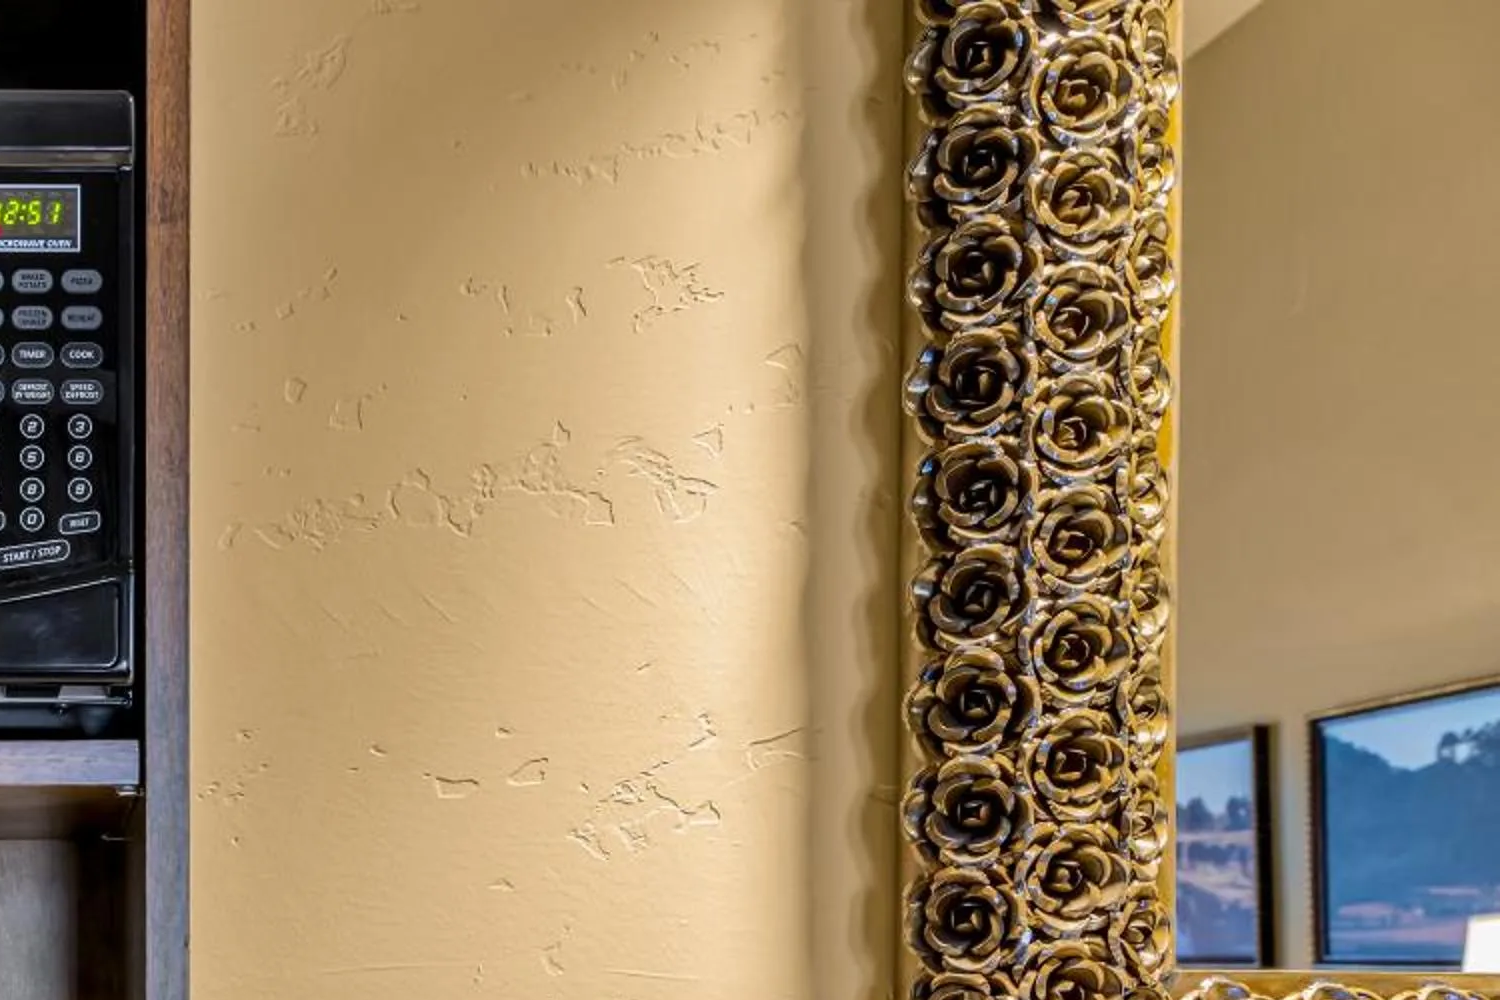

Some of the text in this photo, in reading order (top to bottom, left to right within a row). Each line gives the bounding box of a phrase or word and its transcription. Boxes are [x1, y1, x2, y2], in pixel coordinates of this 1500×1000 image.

[19, 349, 46, 359] TIMER
[69, 349, 95, 359] COOK
[27, 421, 38, 432] 2
[75, 421, 86, 432] 3
[27, 451, 38, 463] 5
[27, 483, 38, 495] 8
[3, 549, 30, 563] START
[38, 545, 61, 558] STOP
